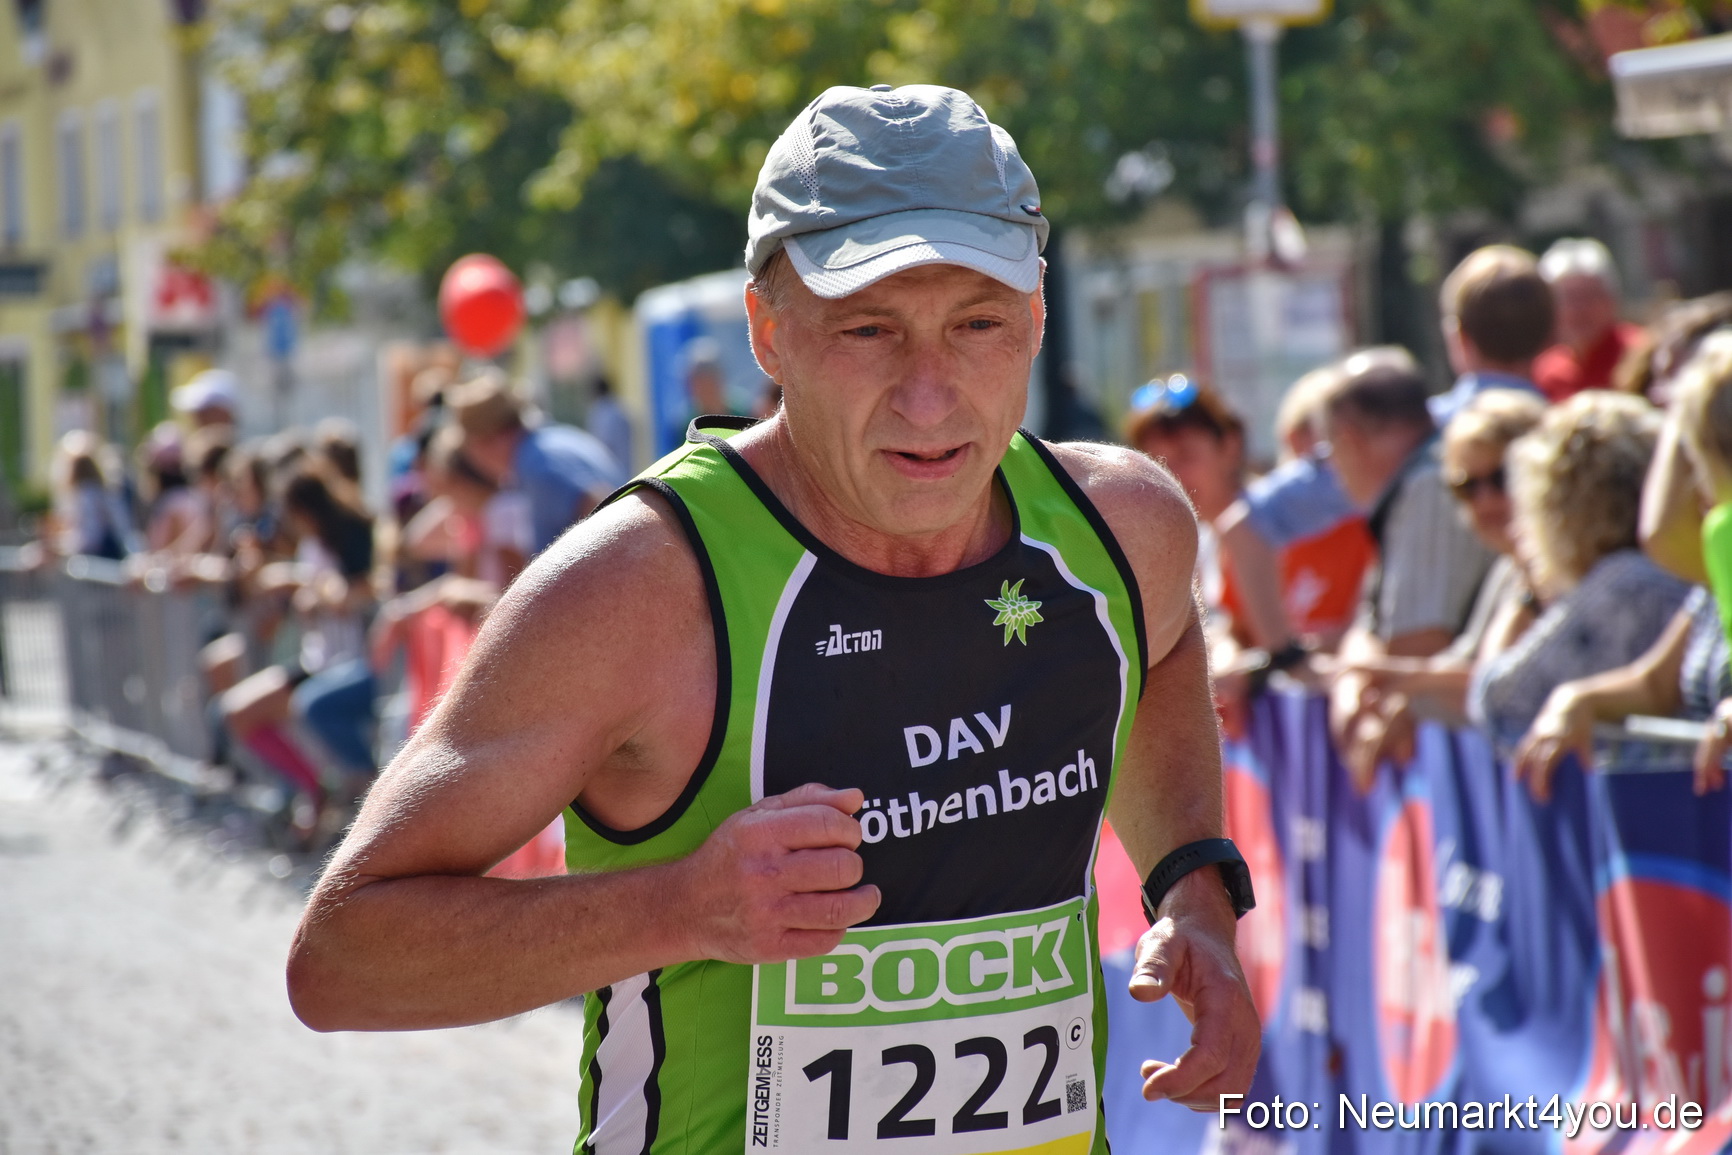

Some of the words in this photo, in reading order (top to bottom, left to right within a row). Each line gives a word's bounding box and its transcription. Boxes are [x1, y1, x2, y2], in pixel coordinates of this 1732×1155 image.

[903, 704, 1012, 768] DAV
[850, 749, 1098, 844] öthenbach
[790, 920, 1069, 1010] BOCK
[776, 1035, 785, 1087] ZEITMESSUNG
[1070, 1024, 1082, 1042] C
[802, 1025, 1062, 1140] 1222
[773, 1092, 782, 1148] TRANSPONDER
